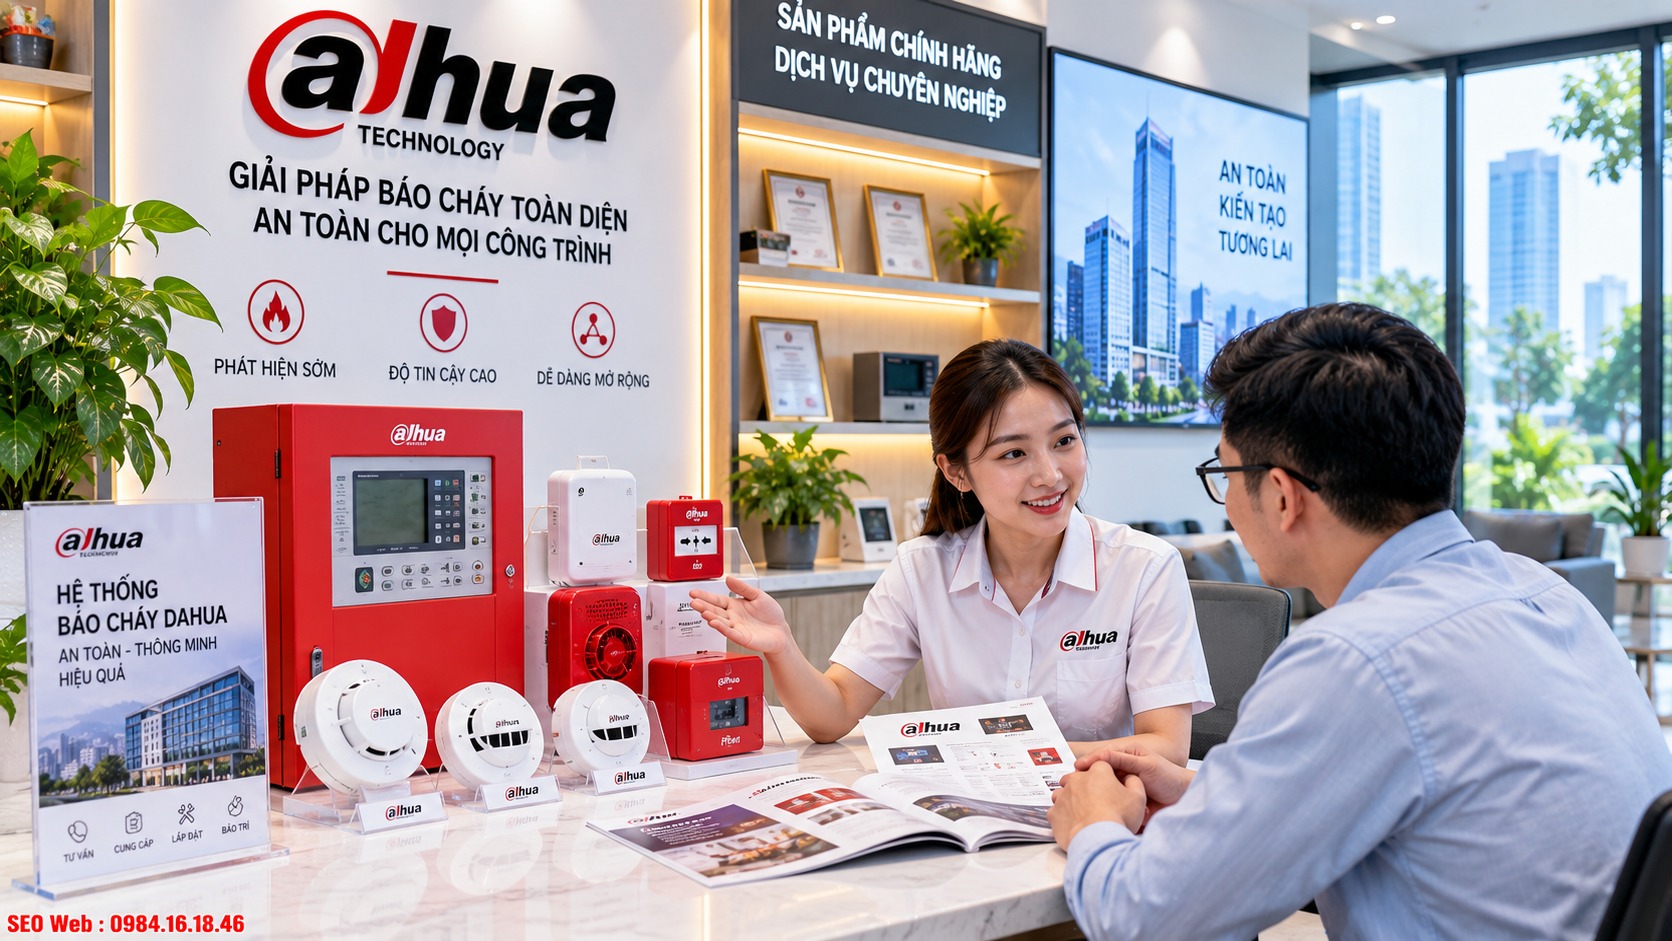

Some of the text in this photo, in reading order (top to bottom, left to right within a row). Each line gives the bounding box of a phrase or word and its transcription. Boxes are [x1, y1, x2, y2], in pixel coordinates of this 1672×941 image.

[777, 0, 1002, 80] SẢN PHẨM CHÍNH HÃNG
[775, 45, 1007, 123] DỊCH VỤ CHUYÊN NGHIỆP
[357, 124, 504, 161] TECHNOLOGY
[1219, 159, 1286, 194] AN TOÀN
[229, 155, 627, 235] GIẢI PHÁP BÁO CHÁY TOÀN DIỆN
[1219, 191, 1286, 231] KIẾN TẠO
[253, 206, 611, 265] AN TOÀN CHO MỌI CÔNG TRÌNH
[1218, 230, 1292, 261] TƯƠNG LAI
[214, 355, 257, 376] PHÁT
[262, 356, 297, 380] HIỆN
[388, 362, 497, 386] ĐỘ TIN CẬY CAO
[557, 368, 591, 386] DÀNG
[617, 371, 650, 390] RỘNG
[57, 573, 158, 608] HỆ THỐNG
[58, 605, 228, 636] BÁO CHÁY DAHUA
[58, 648, 79, 664] AN
[83, 642, 121, 661] TOÀN
[134, 637, 181, 656] THÔNG
[185, 636, 217, 652] MINH
[59, 662, 126, 689] HIỆU QUẢ
[63, 852, 75, 863] TƯ
[113, 841, 137, 853] CUNG
